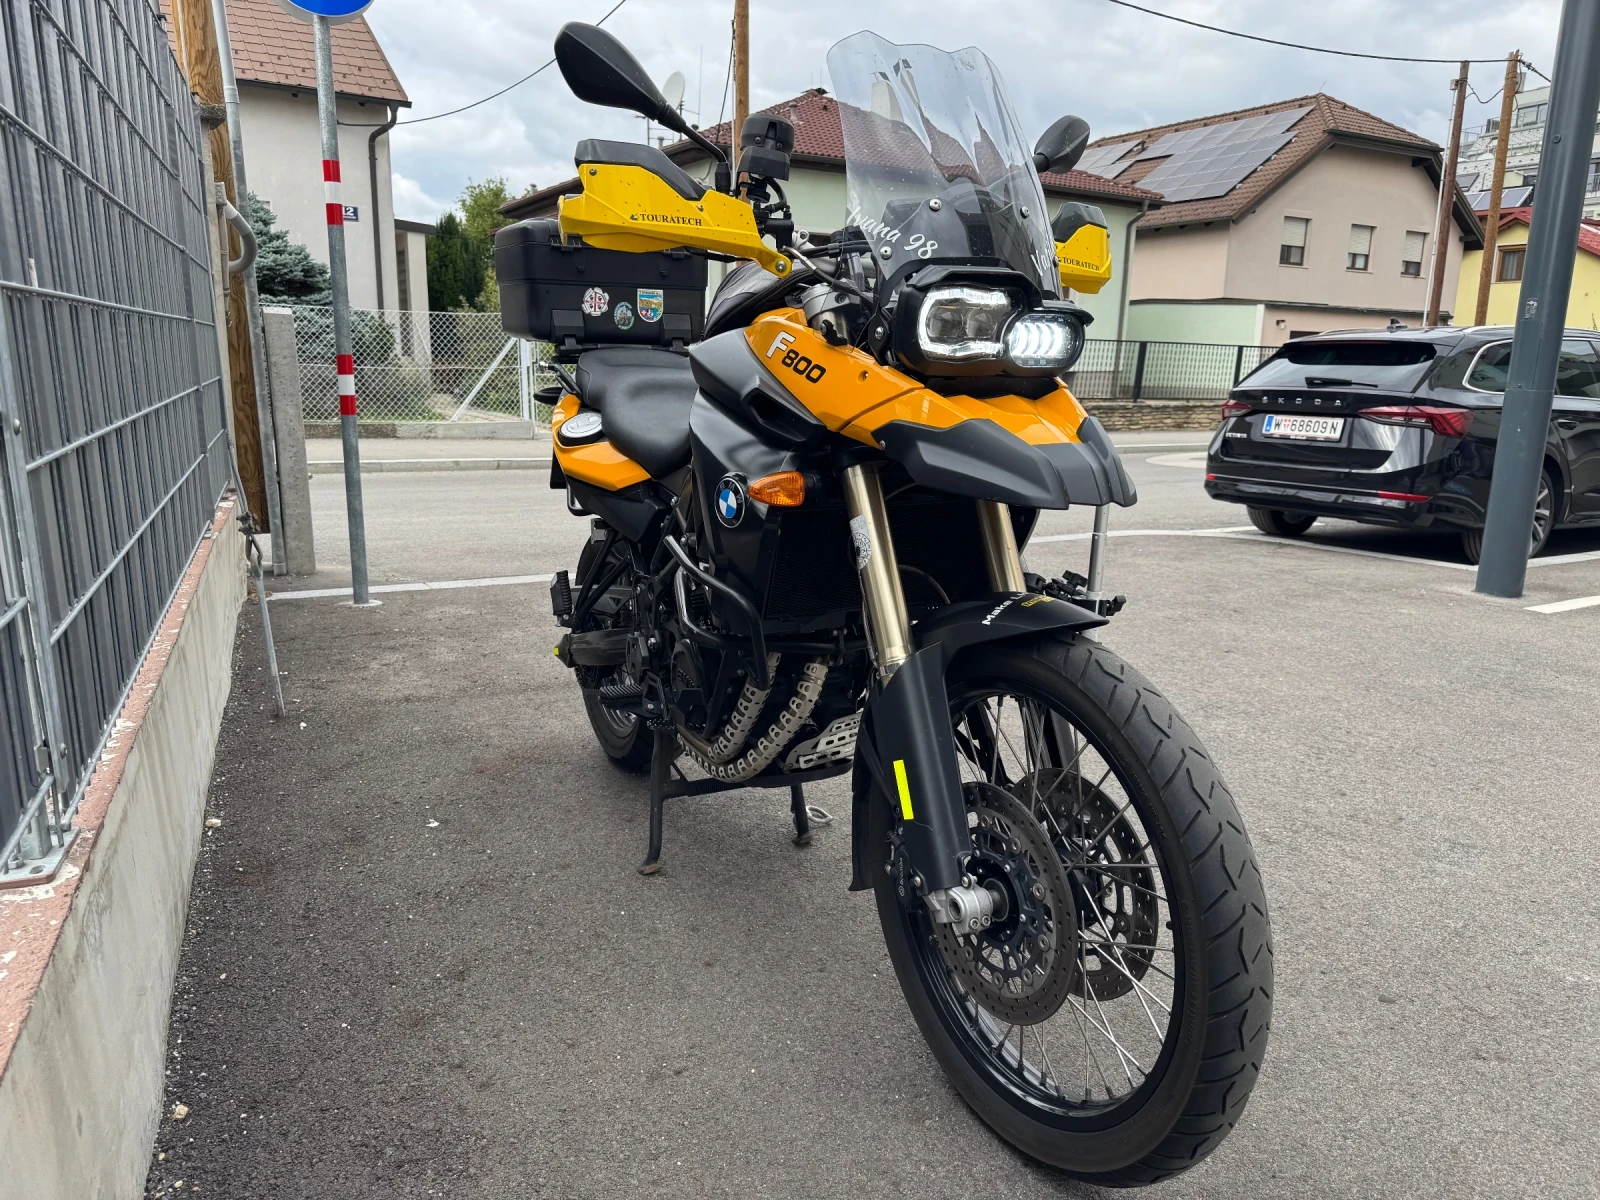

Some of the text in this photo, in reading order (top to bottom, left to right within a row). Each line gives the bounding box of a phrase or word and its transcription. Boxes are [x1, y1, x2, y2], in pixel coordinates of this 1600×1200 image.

[639, 213, 702, 227] TOURATECH
[903, 233, 938, 259] 98
[1062, 256, 1100, 272] TOURATECH
[719, 481, 744, 504] BMW
[981, 600, 1013, 626] Make
